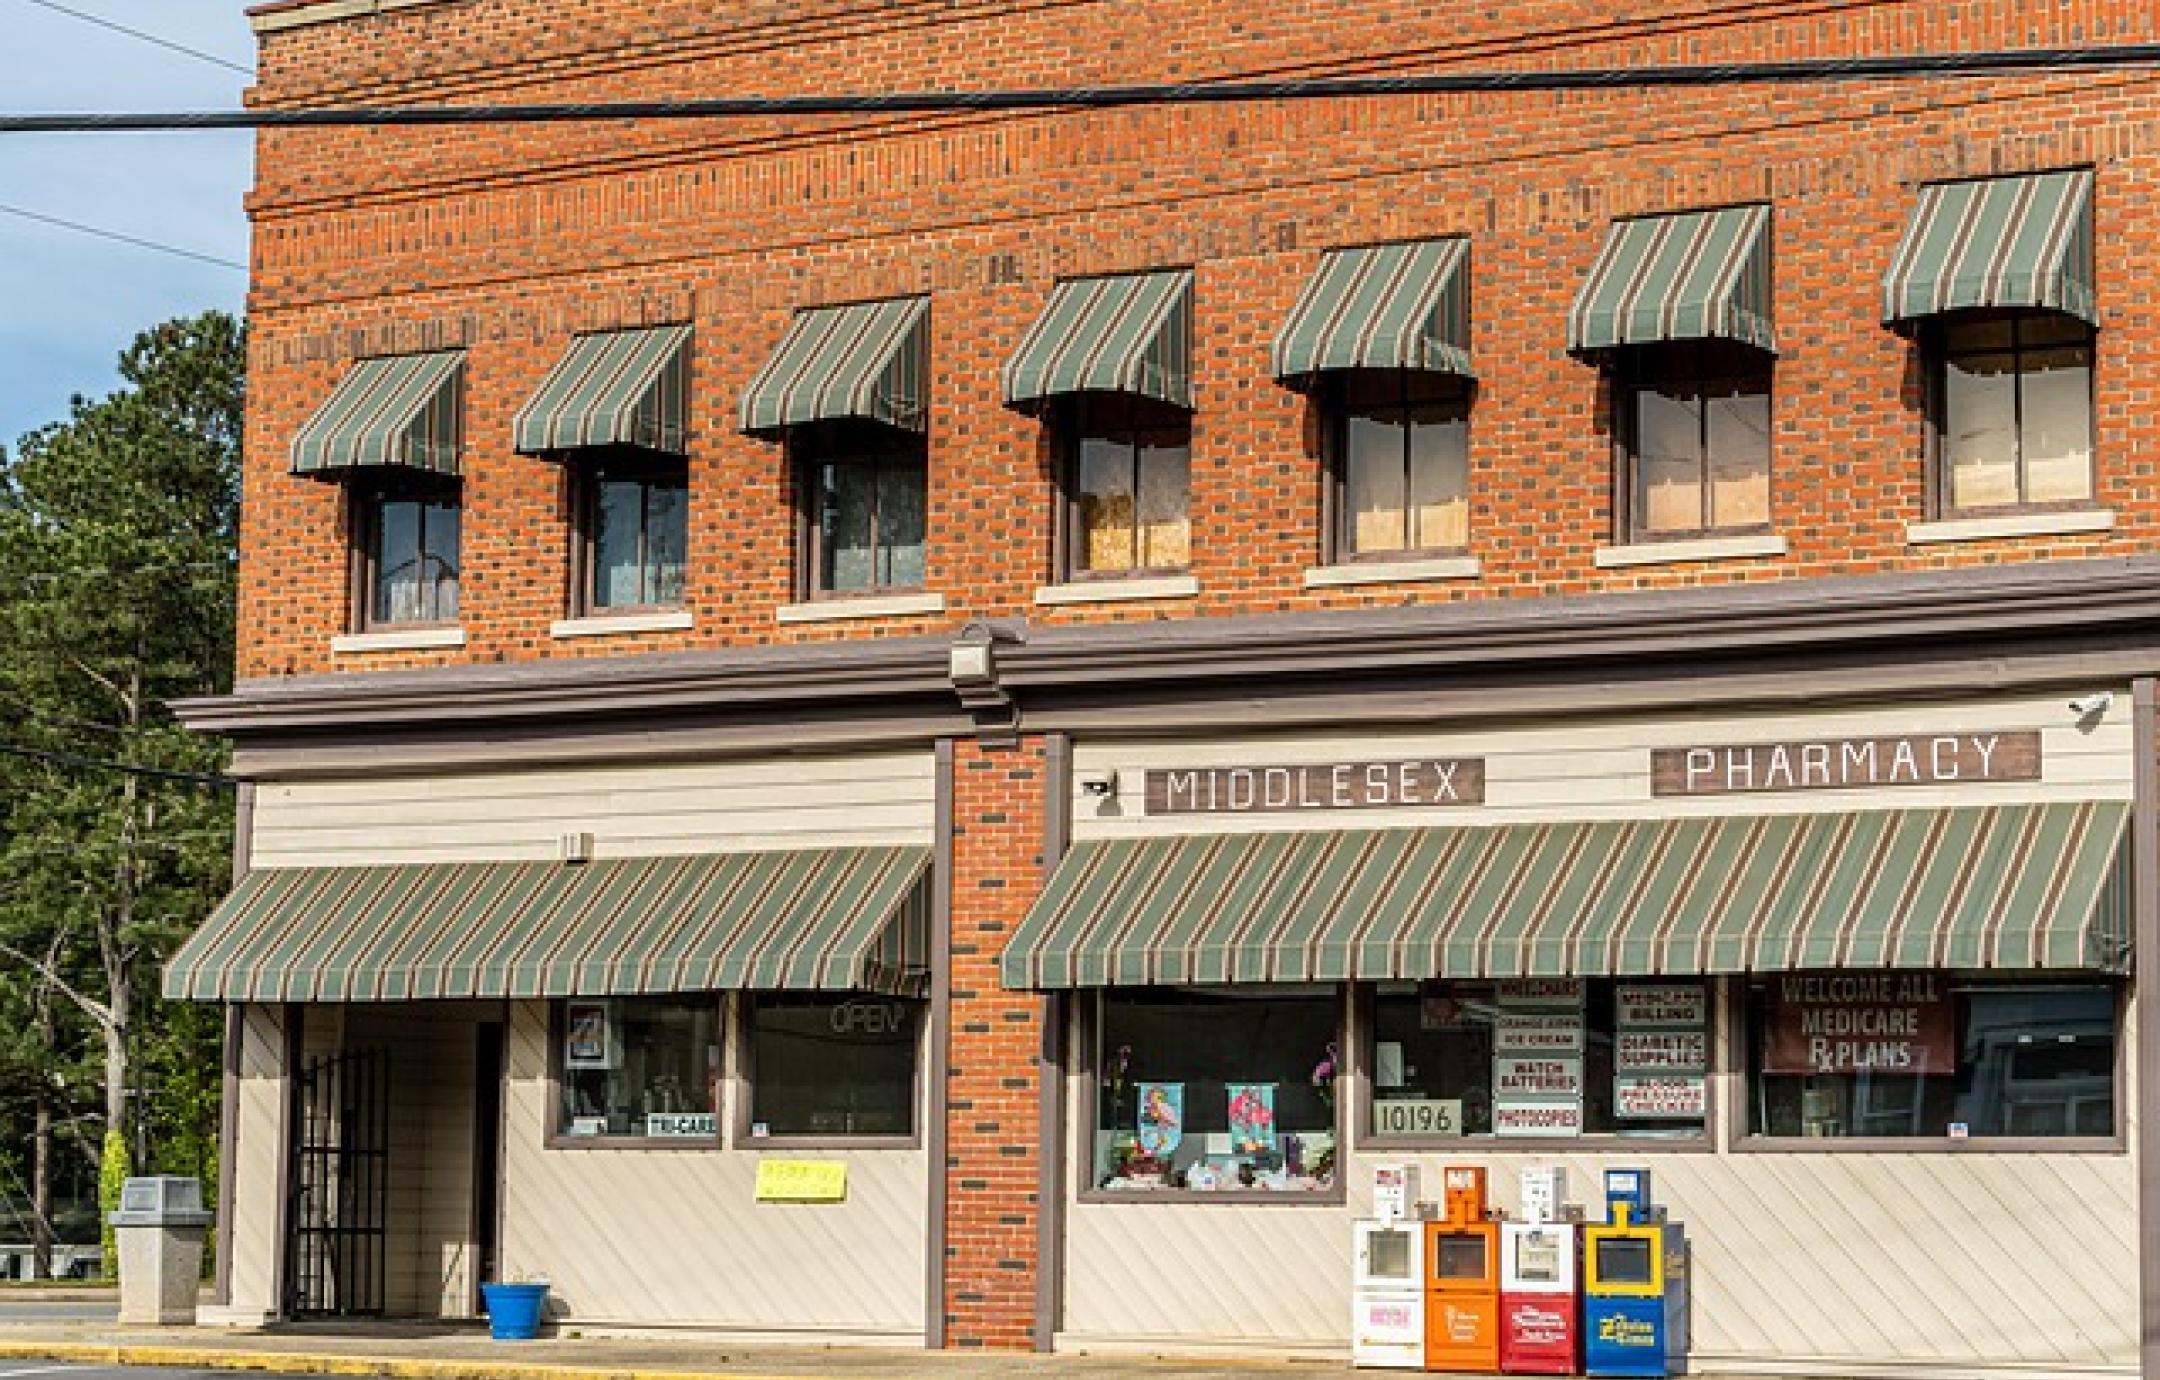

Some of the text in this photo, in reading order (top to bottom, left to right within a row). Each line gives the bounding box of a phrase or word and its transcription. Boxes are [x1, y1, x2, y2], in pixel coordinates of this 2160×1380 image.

[1685, 734, 2000, 792] PHARMACY
[1166, 760, 1459, 810] MIDDLESEX
[1782, 975, 1937, 1003] WELCOME ALL
[829, 1003, 904, 1033] OPEN
[1801, 1008, 1919, 1036] MEDICARE
[1514, 1062, 1565, 1075] WATCH
[1836, 1041, 1912, 1068] PLANS
[1501, 1075, 1578, 1090] BATTERIES
[1381, 1104, 1453, 1133] 10196
